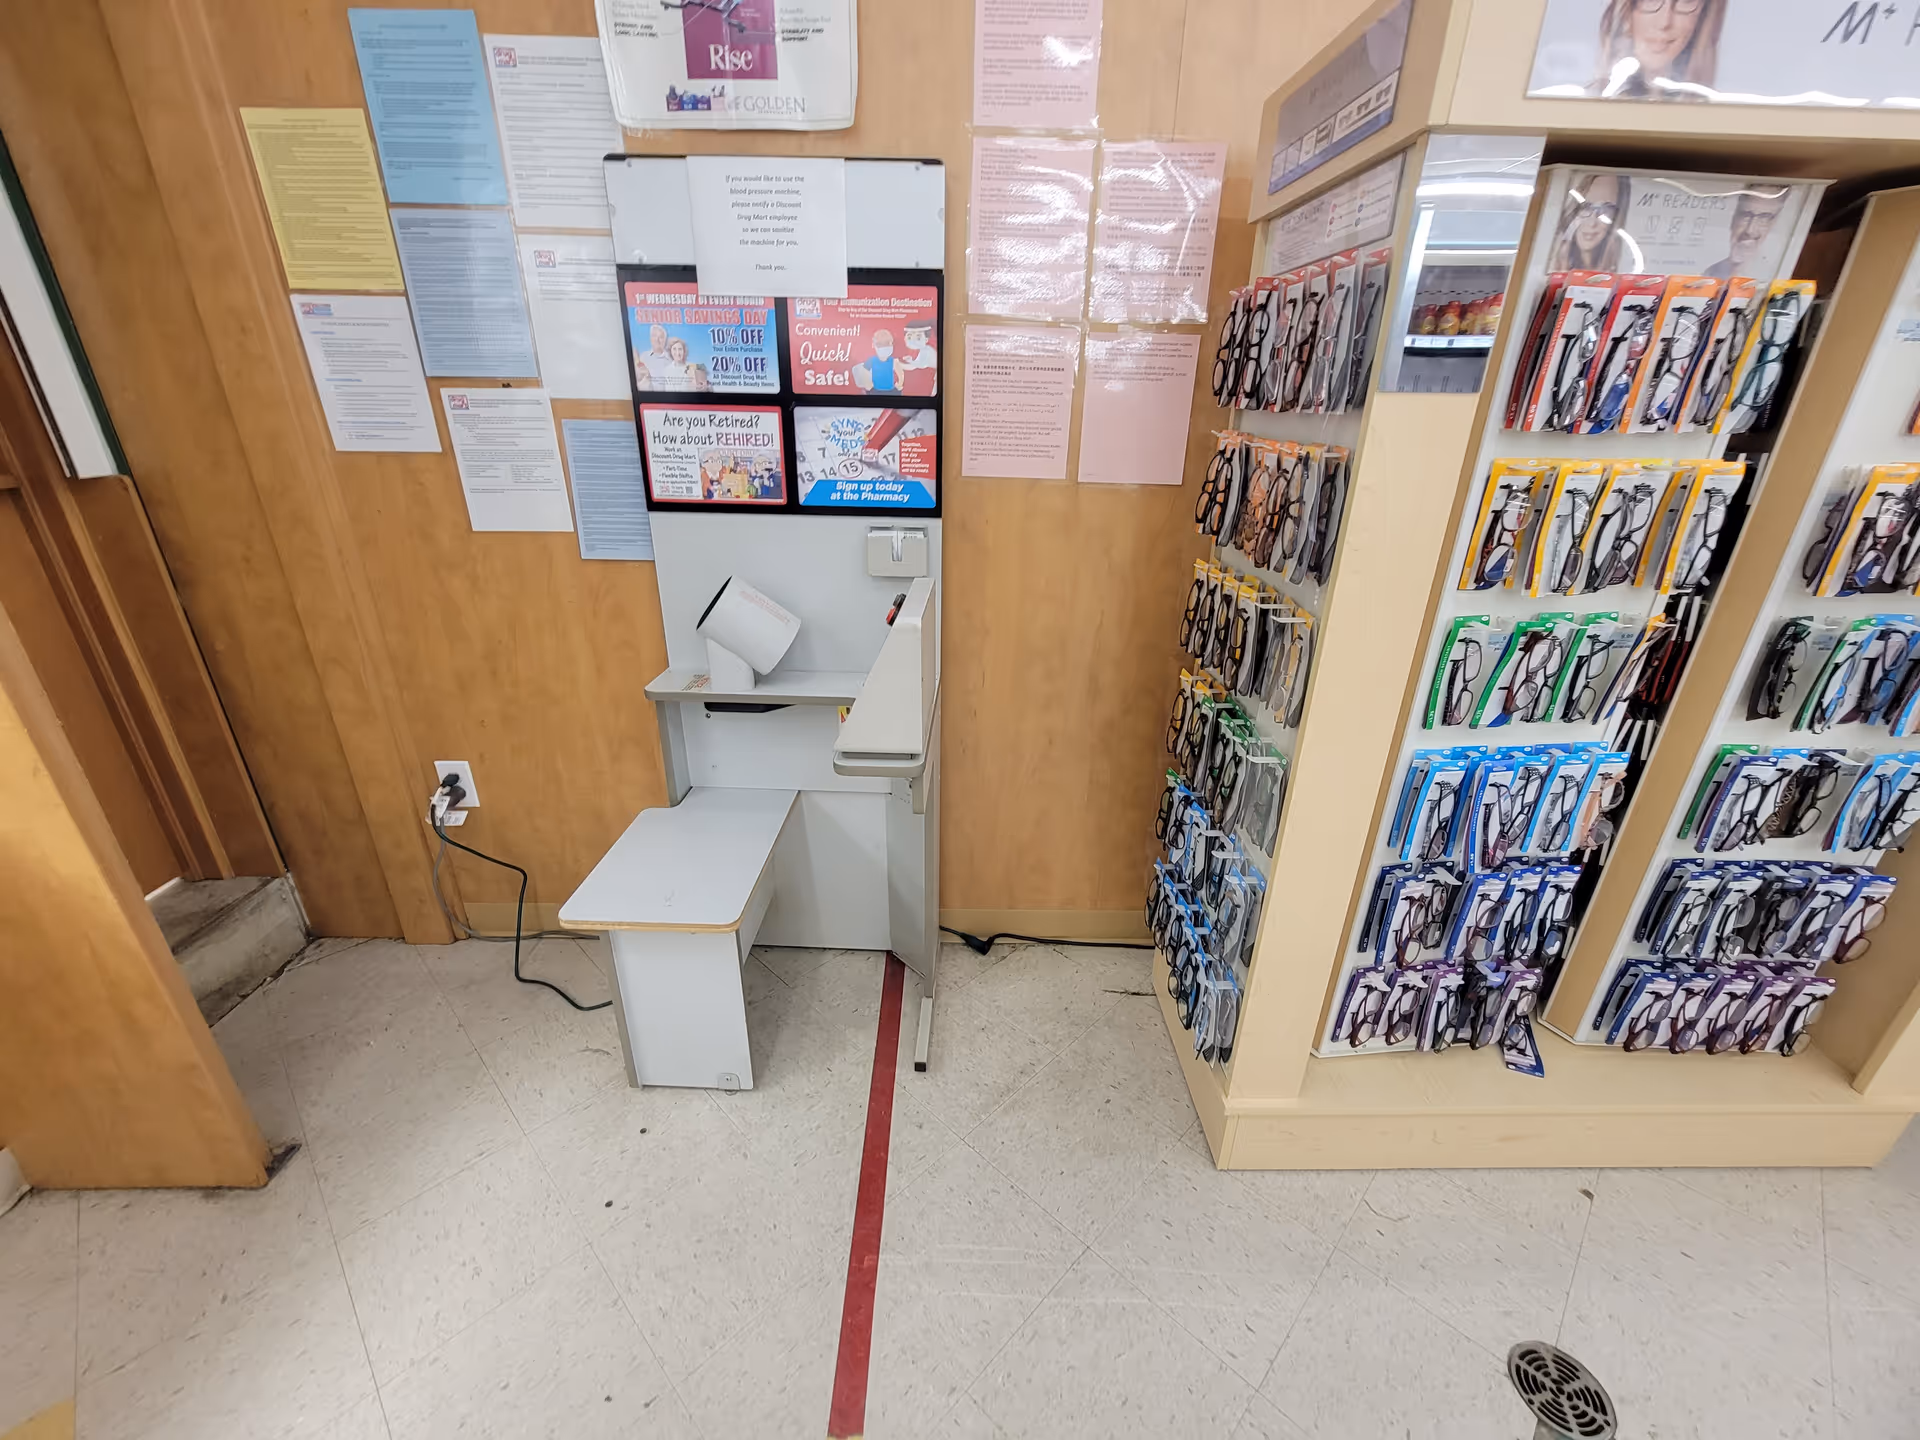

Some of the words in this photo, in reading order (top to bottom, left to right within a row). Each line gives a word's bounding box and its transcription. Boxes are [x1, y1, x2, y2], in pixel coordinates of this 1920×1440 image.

[709, 44, 753, 72] Rise
[743, 95, 806, 113] GOLDEN
[725, 175, 730, 183] If
[774, 188, 802, 196] machine,
[752, 201, 770, 209] notify
[1662, 194, 1727, 211] READERS
[769, 214, 798, 222] employee
[776, 239, 784, 248] for
[785, 240, 799, 248] you.
[645, 293, 697, 305] WEDNESDAY
[709, 296, 736, 306] EVERY
[823, 298, 839, 306] Your
[840, 297, 890, 307] Immunization
[891, 298, 932, 308] Destination
[636, 308, 683, 325] SENIOR
[684, 308, 741, 326] SAVINGS
[743, 308, 768, 326] DAY
[708, 328, 738, 346] 10%
[740, 328, 764, 346] OFF
[795, 323, 861, 337] Convenient!
[800, 341, 852, 365] Quick!
[712, 356, 742, 373] 20%
[744, 356, 768, 373] OFF
[805, 370, 850, 386] Safe!
[663, 412, 684, 427] Are
[685, 416, 706, 430] you
[708, 414, 760, 429] Retired?
[830, 417, 865, 433] SYNC
[652, 431, 678, 445] How
[680, 431, 714, 446] about
[716, 432, 774, 447] REHIRED!
[830, 435, 866, 450] MEDS
[672, 453, 684, 461] Drug
[817, 447, 828, 458] 7
[883, 453, 896, 465] 17
[798, 470, 815, 484] 13
[820, 467, 837, 479] 14
[843, 462, 859, 475] 15
[836, 482, 858, 490] Sign
[860, 483, 873, 491] up
[875, 482, 904, 492] today
[830, 493, 841, 501] at
[843, 492, 860, 501] the
[861, 492, 910, 503] Pharmacy
